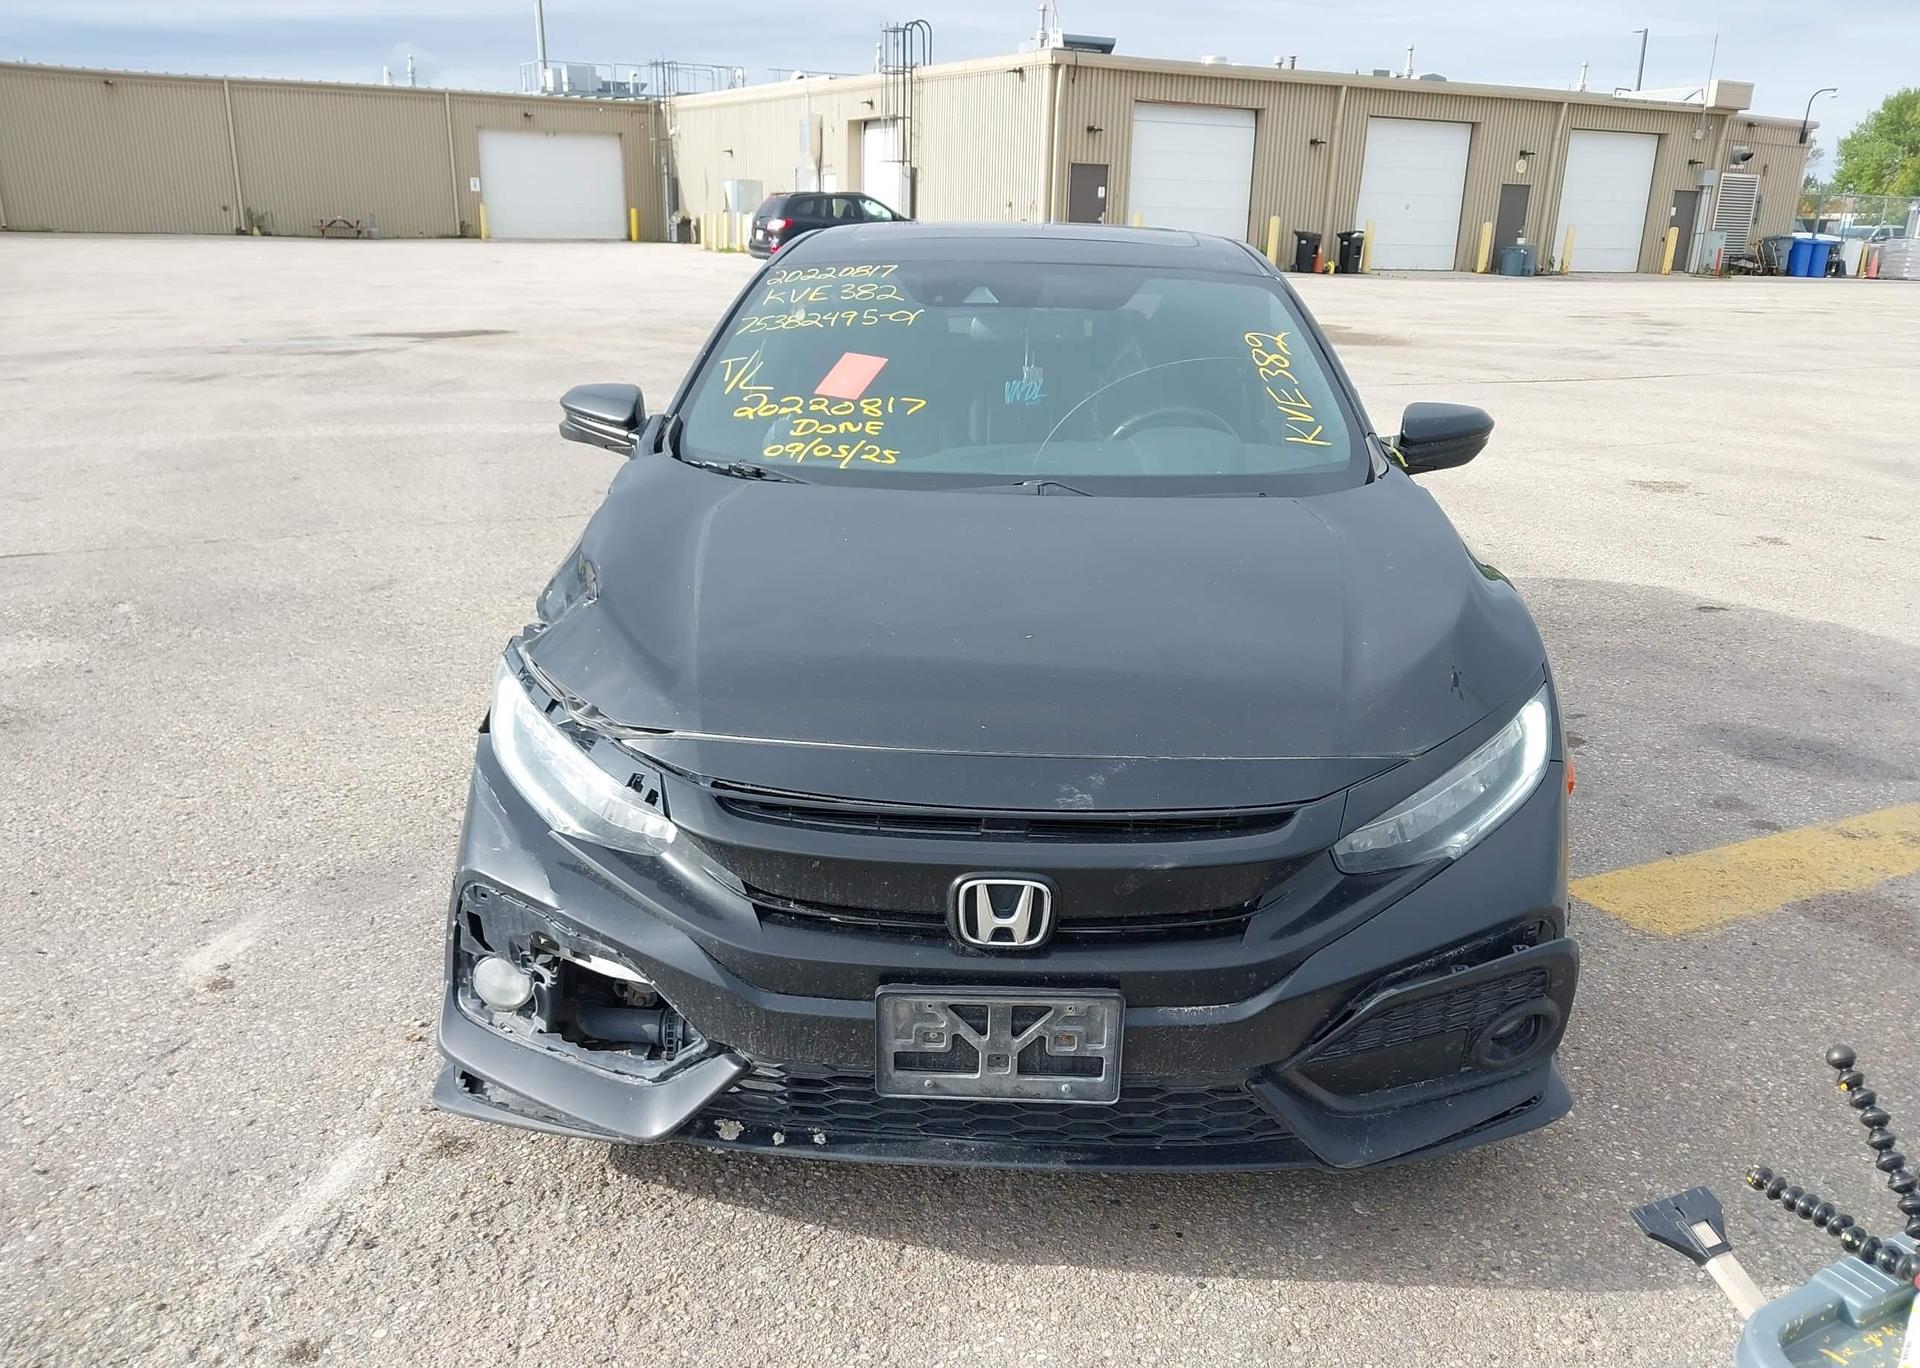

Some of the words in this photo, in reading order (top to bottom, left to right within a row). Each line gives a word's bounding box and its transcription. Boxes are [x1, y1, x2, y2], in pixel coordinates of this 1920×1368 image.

[767, 265, 899, 286] 20220817
[762, 285, 833, 306] KVE
[840, 284, 905, 301] 382
[720, 350, 775, 394] T/L
[733, 393, 927, 419] 20220817
[789, 418, 885, 436] DONE
[763, 437, 901, 469] 09/05/25
